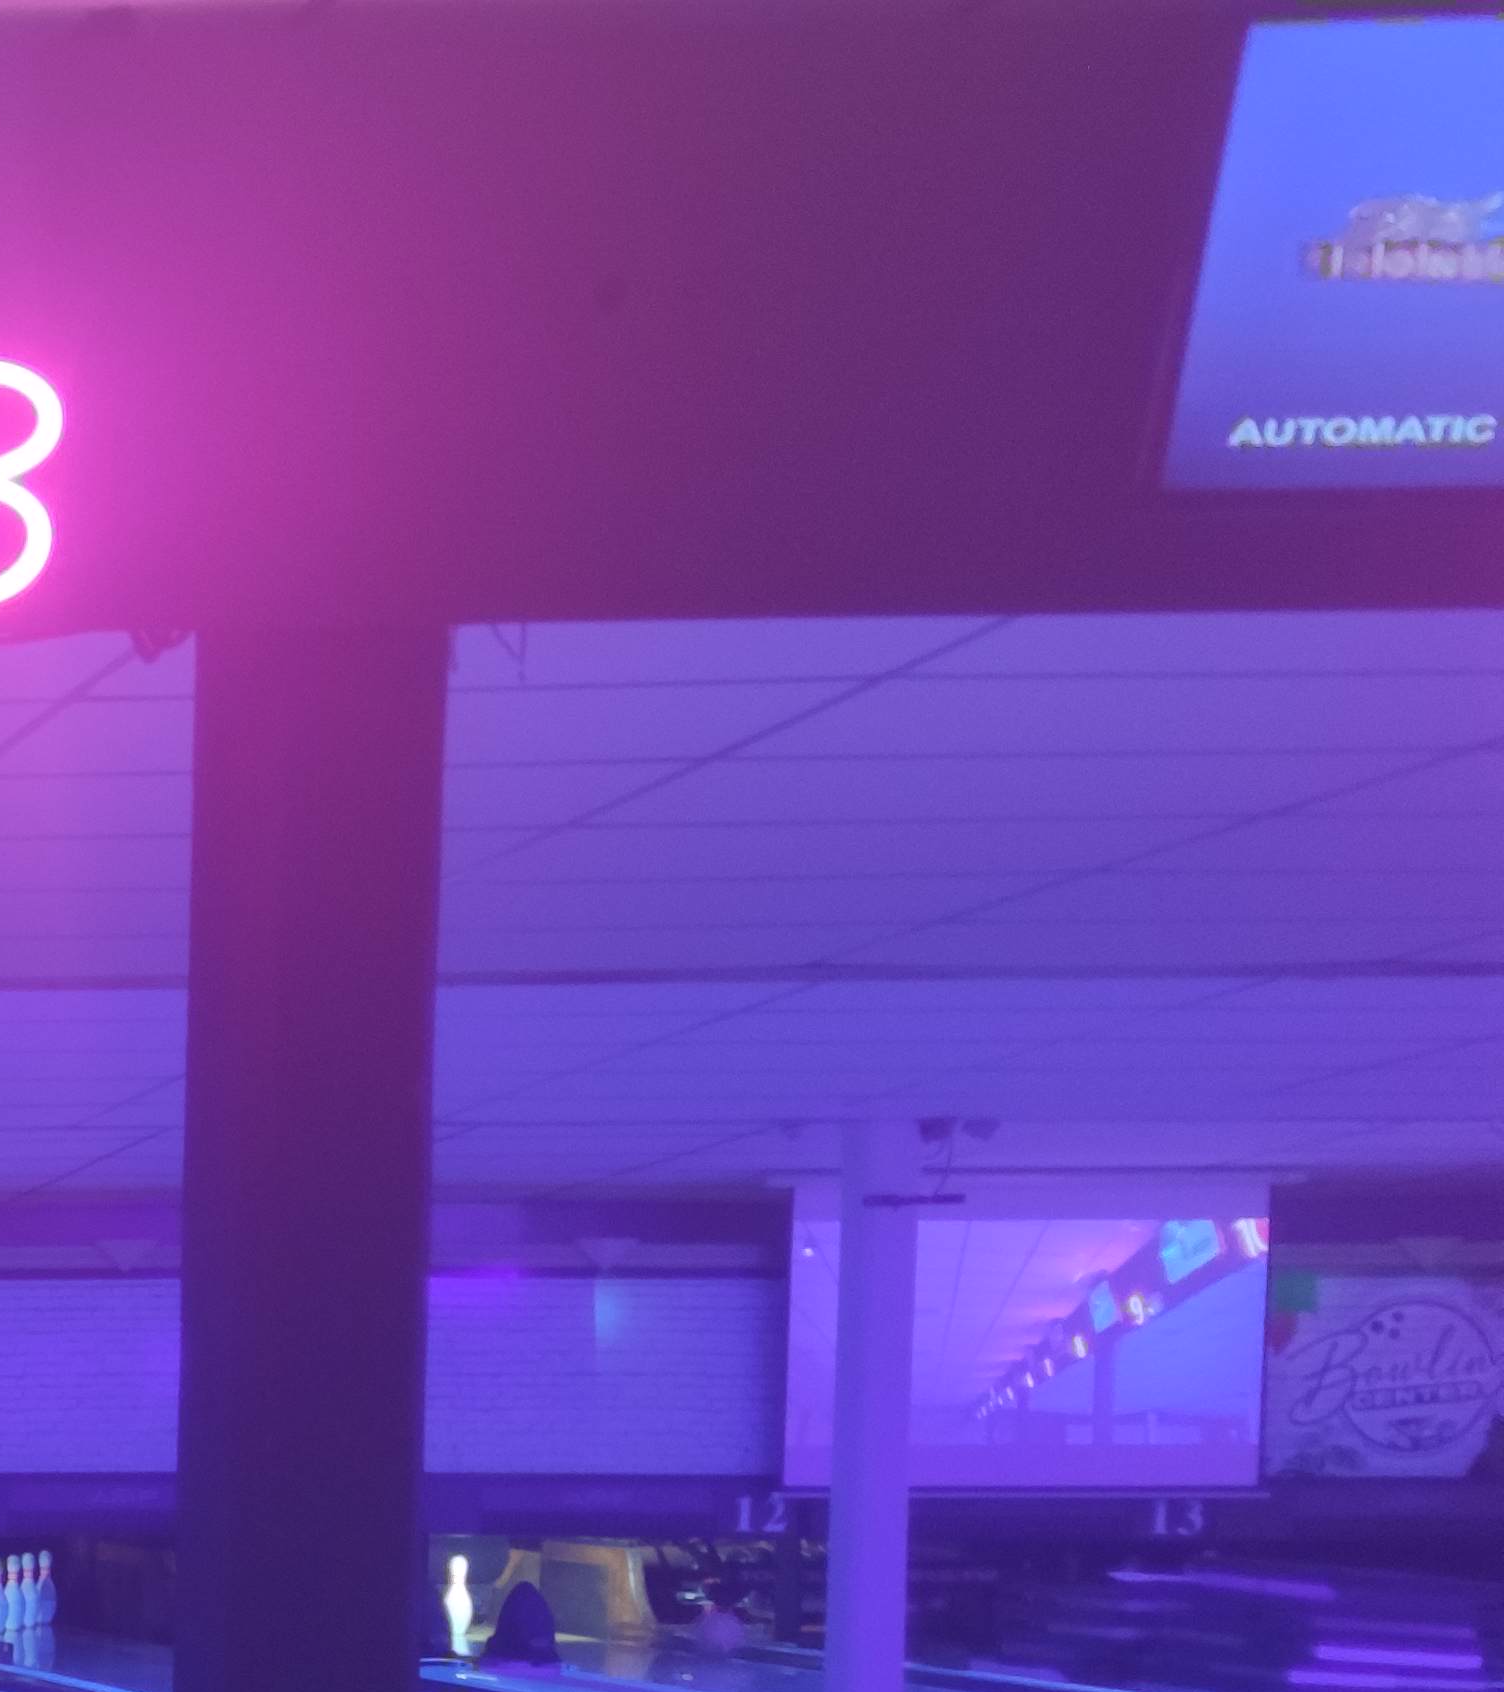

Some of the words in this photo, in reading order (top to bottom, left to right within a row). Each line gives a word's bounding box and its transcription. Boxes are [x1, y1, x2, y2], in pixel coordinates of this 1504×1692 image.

[1229, 415, 1496, 447] AUTOMATIC
[735, 1496, 788, 1533] 12
[1152, 1498, 1204, 1536] 13
